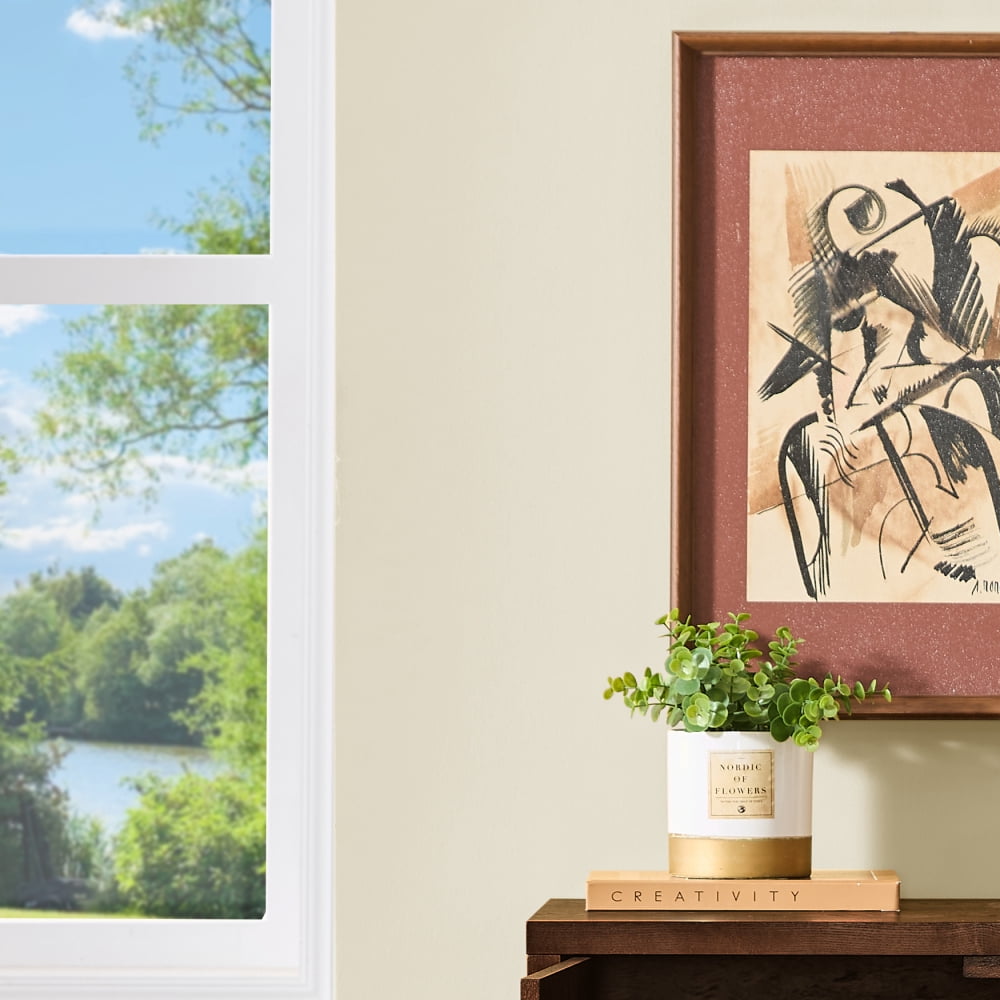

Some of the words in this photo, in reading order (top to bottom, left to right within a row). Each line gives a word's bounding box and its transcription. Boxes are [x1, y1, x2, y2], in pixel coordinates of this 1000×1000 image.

[720, 763, 762, 771] NORDIC
[733, 775, 747, 783] OF
[715, 786, 767, 795] FLOWERS
[611, 890, 800, 903] CREATIVITY
